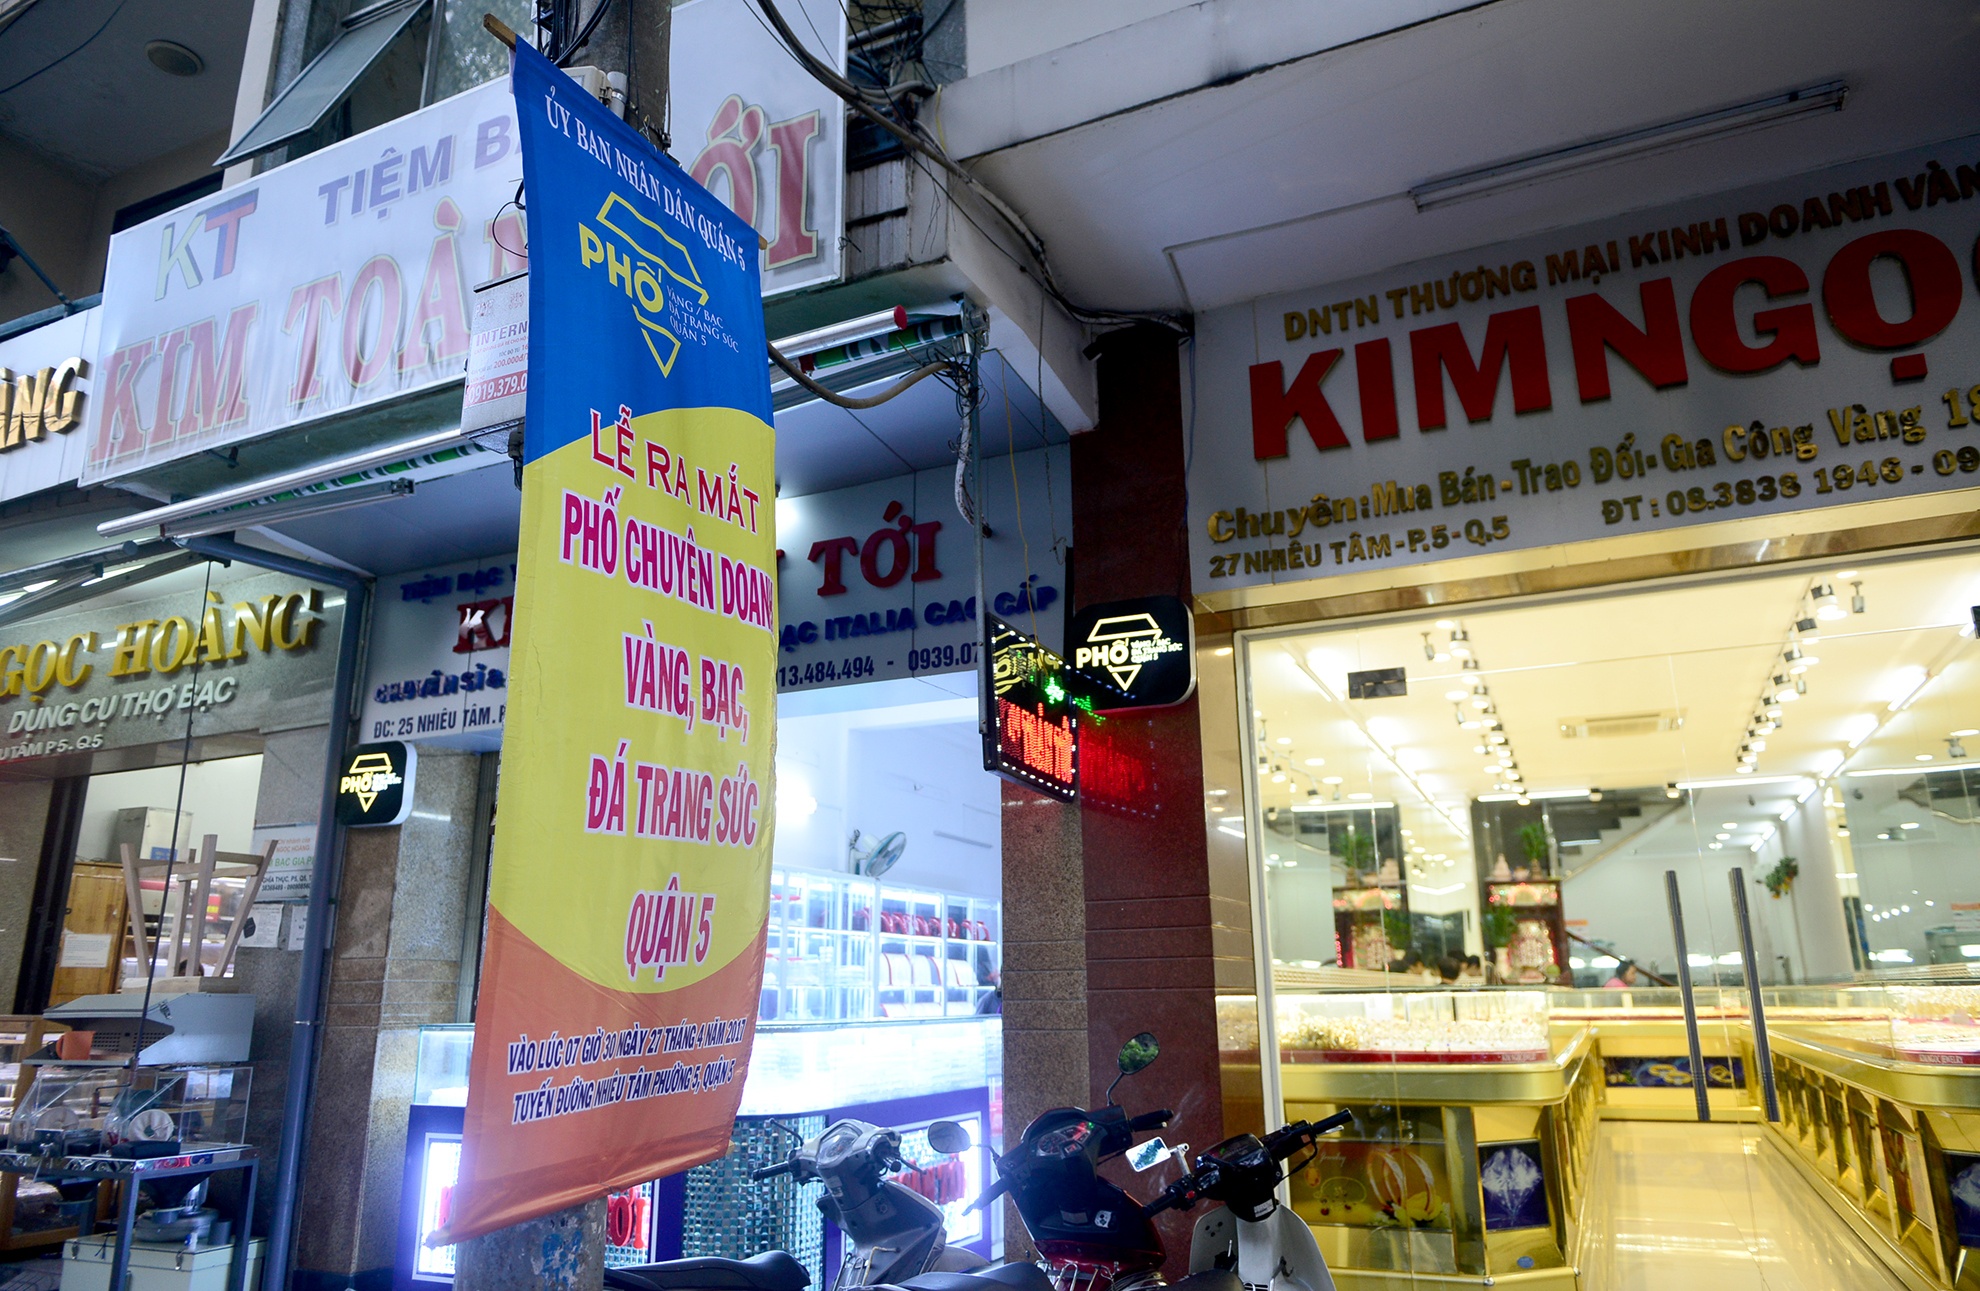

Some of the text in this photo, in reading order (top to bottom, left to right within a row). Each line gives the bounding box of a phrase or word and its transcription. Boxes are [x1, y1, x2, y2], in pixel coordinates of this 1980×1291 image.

[318, 134, 455, 226] TIỆM
[545, 85, 746, 271] ỦY BAN NHÂN DÂN QUẬN 5
[686, 93, 820, 271] ỚI
[155, 187, 259, 301] KT
[579, 222, 664, 313] PHỐ
[1284, 295, 1380, 341] DNTN
[1386, 260, 1538, 319] THƯƠNG
[1546, 240, 1620, 285] MẠI
[1628, 217, 1731, 268] KINH
[1738, 182, 1893, 247] DOANH
[476, 320, 528, 346] INTERN
[667, 285, 693, 312] VÀNG
[704, 310, 723, 329] BẠC
[670, 316, 707, 346] QUẬN 5
[682, 311, 719, 339] TRANG
[88, 300, 261, 467] KIM
[591, 404, 760, 535] LỄ RA MẮT
[1723, 420, 1818, 461] Công
[1827, 404, 1927, 446] Vàng
[1666, 471, 1801, 516] 08.3838
[1813, 456, 1903, 495] 1946
[560, 483, 624, 578] PHỐ
[625, 516, 717, 614] CHUYÊN
[807, 500, 942, 597] TỚI
[107, 587, 318, 678] HOÀNG
[779, 621, 818, 653] ẠC
[825, 607, 917, 641] ITALIA
[994, 573, 1058, 616] CẤP
[1076, 637, 1129, 669] PHỐ
[8, 677, 237, 738] DỤNG CỤ THỢ BẠC
[623, 619, 749, 745] VÀNG, BẠC,
[777, 654, 875, 688] 13.484.494
[374, 720, 395, 739] ĐC:
[398, 717, 414, 736] 25
[417, 707, 457, 733] NHIÊU
[585, 739, 759, 849] ĐÁ TRANG SỨC
[624, 873, 716, 982] QUẬN 5
[508, 1017, 747, 1075] VÀO LÚC 07 GIỜ 30 NGÀY 27 THÁNG 4 NĂM 2017
[512, 1077, 557, 1125] TUYẾN
[554, 1075, 594, 1116] ĐƯỜNG
[593, 1068, 627, 1108] NHIÊU
[625, 1065, 654, 1101] TÂM
[651, 1061, 693, 1096] PHƯỜNG
[703, 1055, 729, 1092] QUẬN
[727, 1058, 736, 1084] 5
